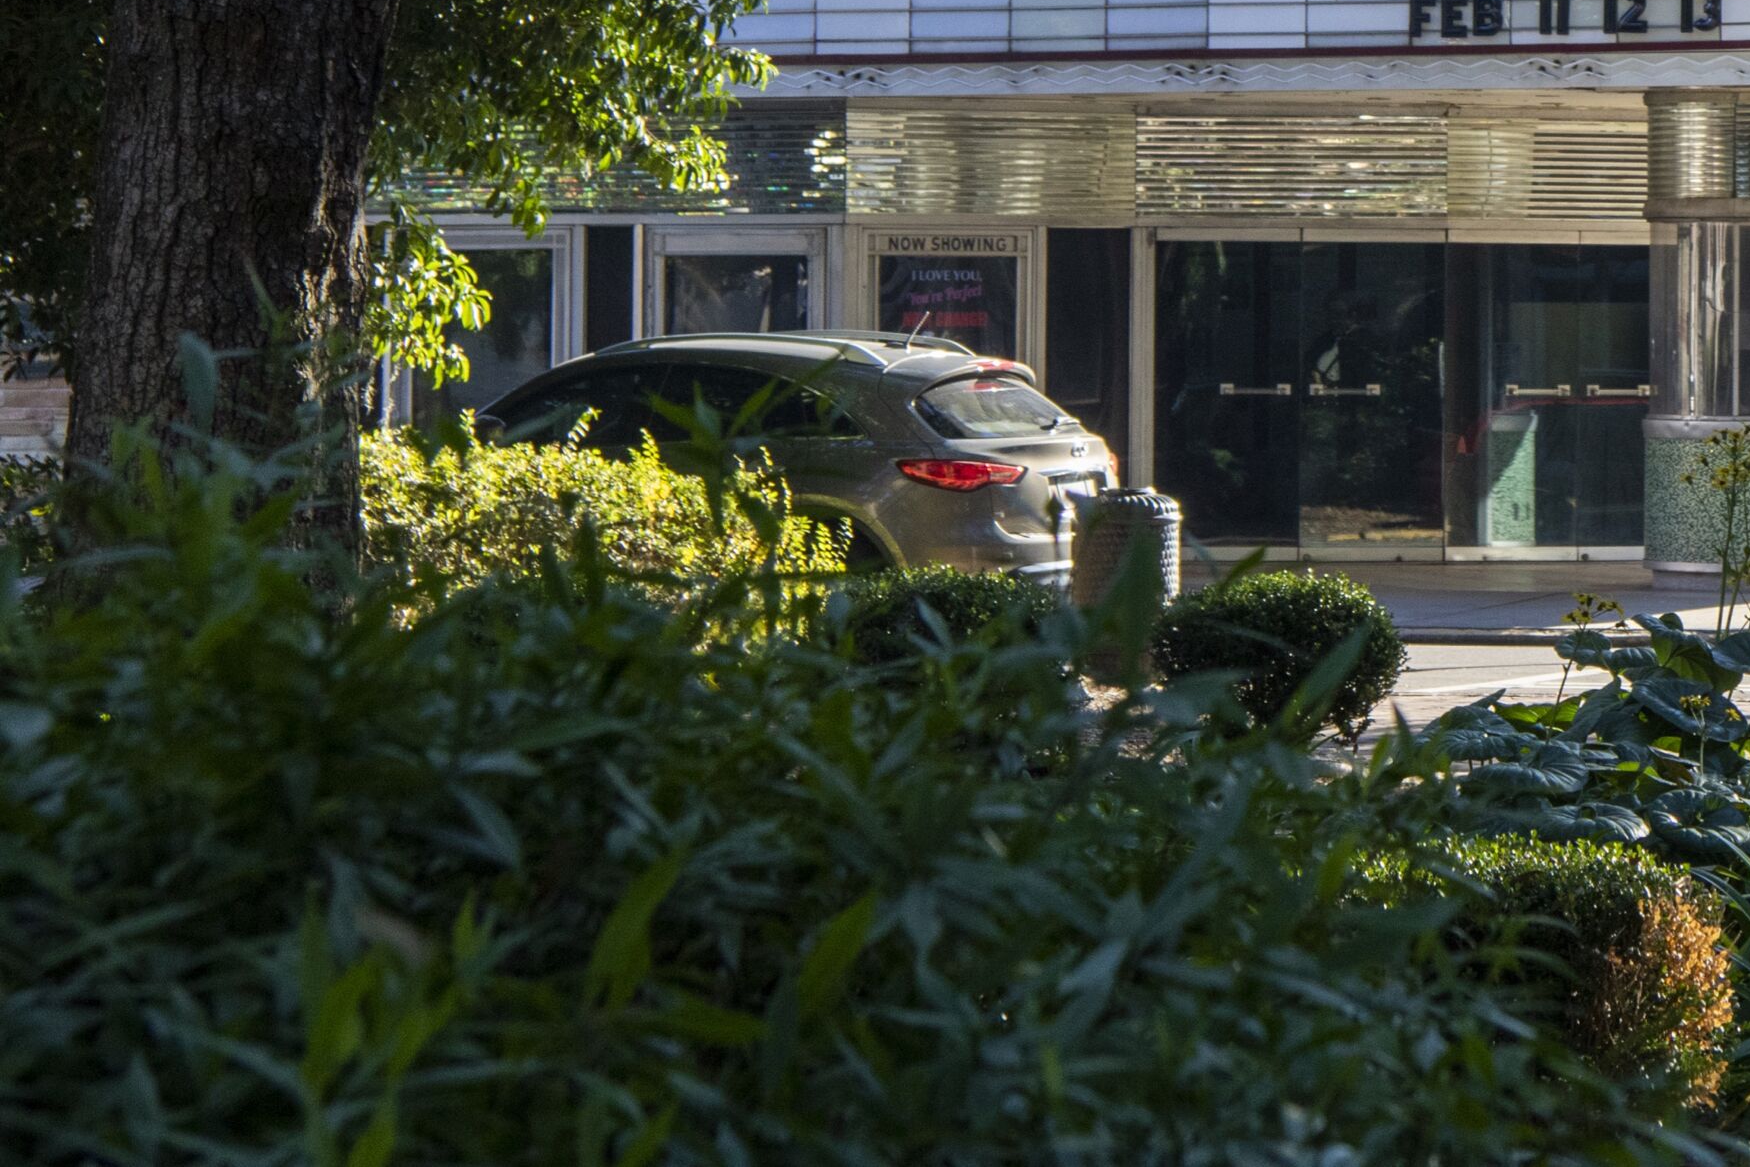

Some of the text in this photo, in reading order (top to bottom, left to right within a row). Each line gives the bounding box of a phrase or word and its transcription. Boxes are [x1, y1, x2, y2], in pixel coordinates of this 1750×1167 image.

[888, 236, 1007, 251] NOW SHOWING
[919, 269, 951, 282] LOVE
